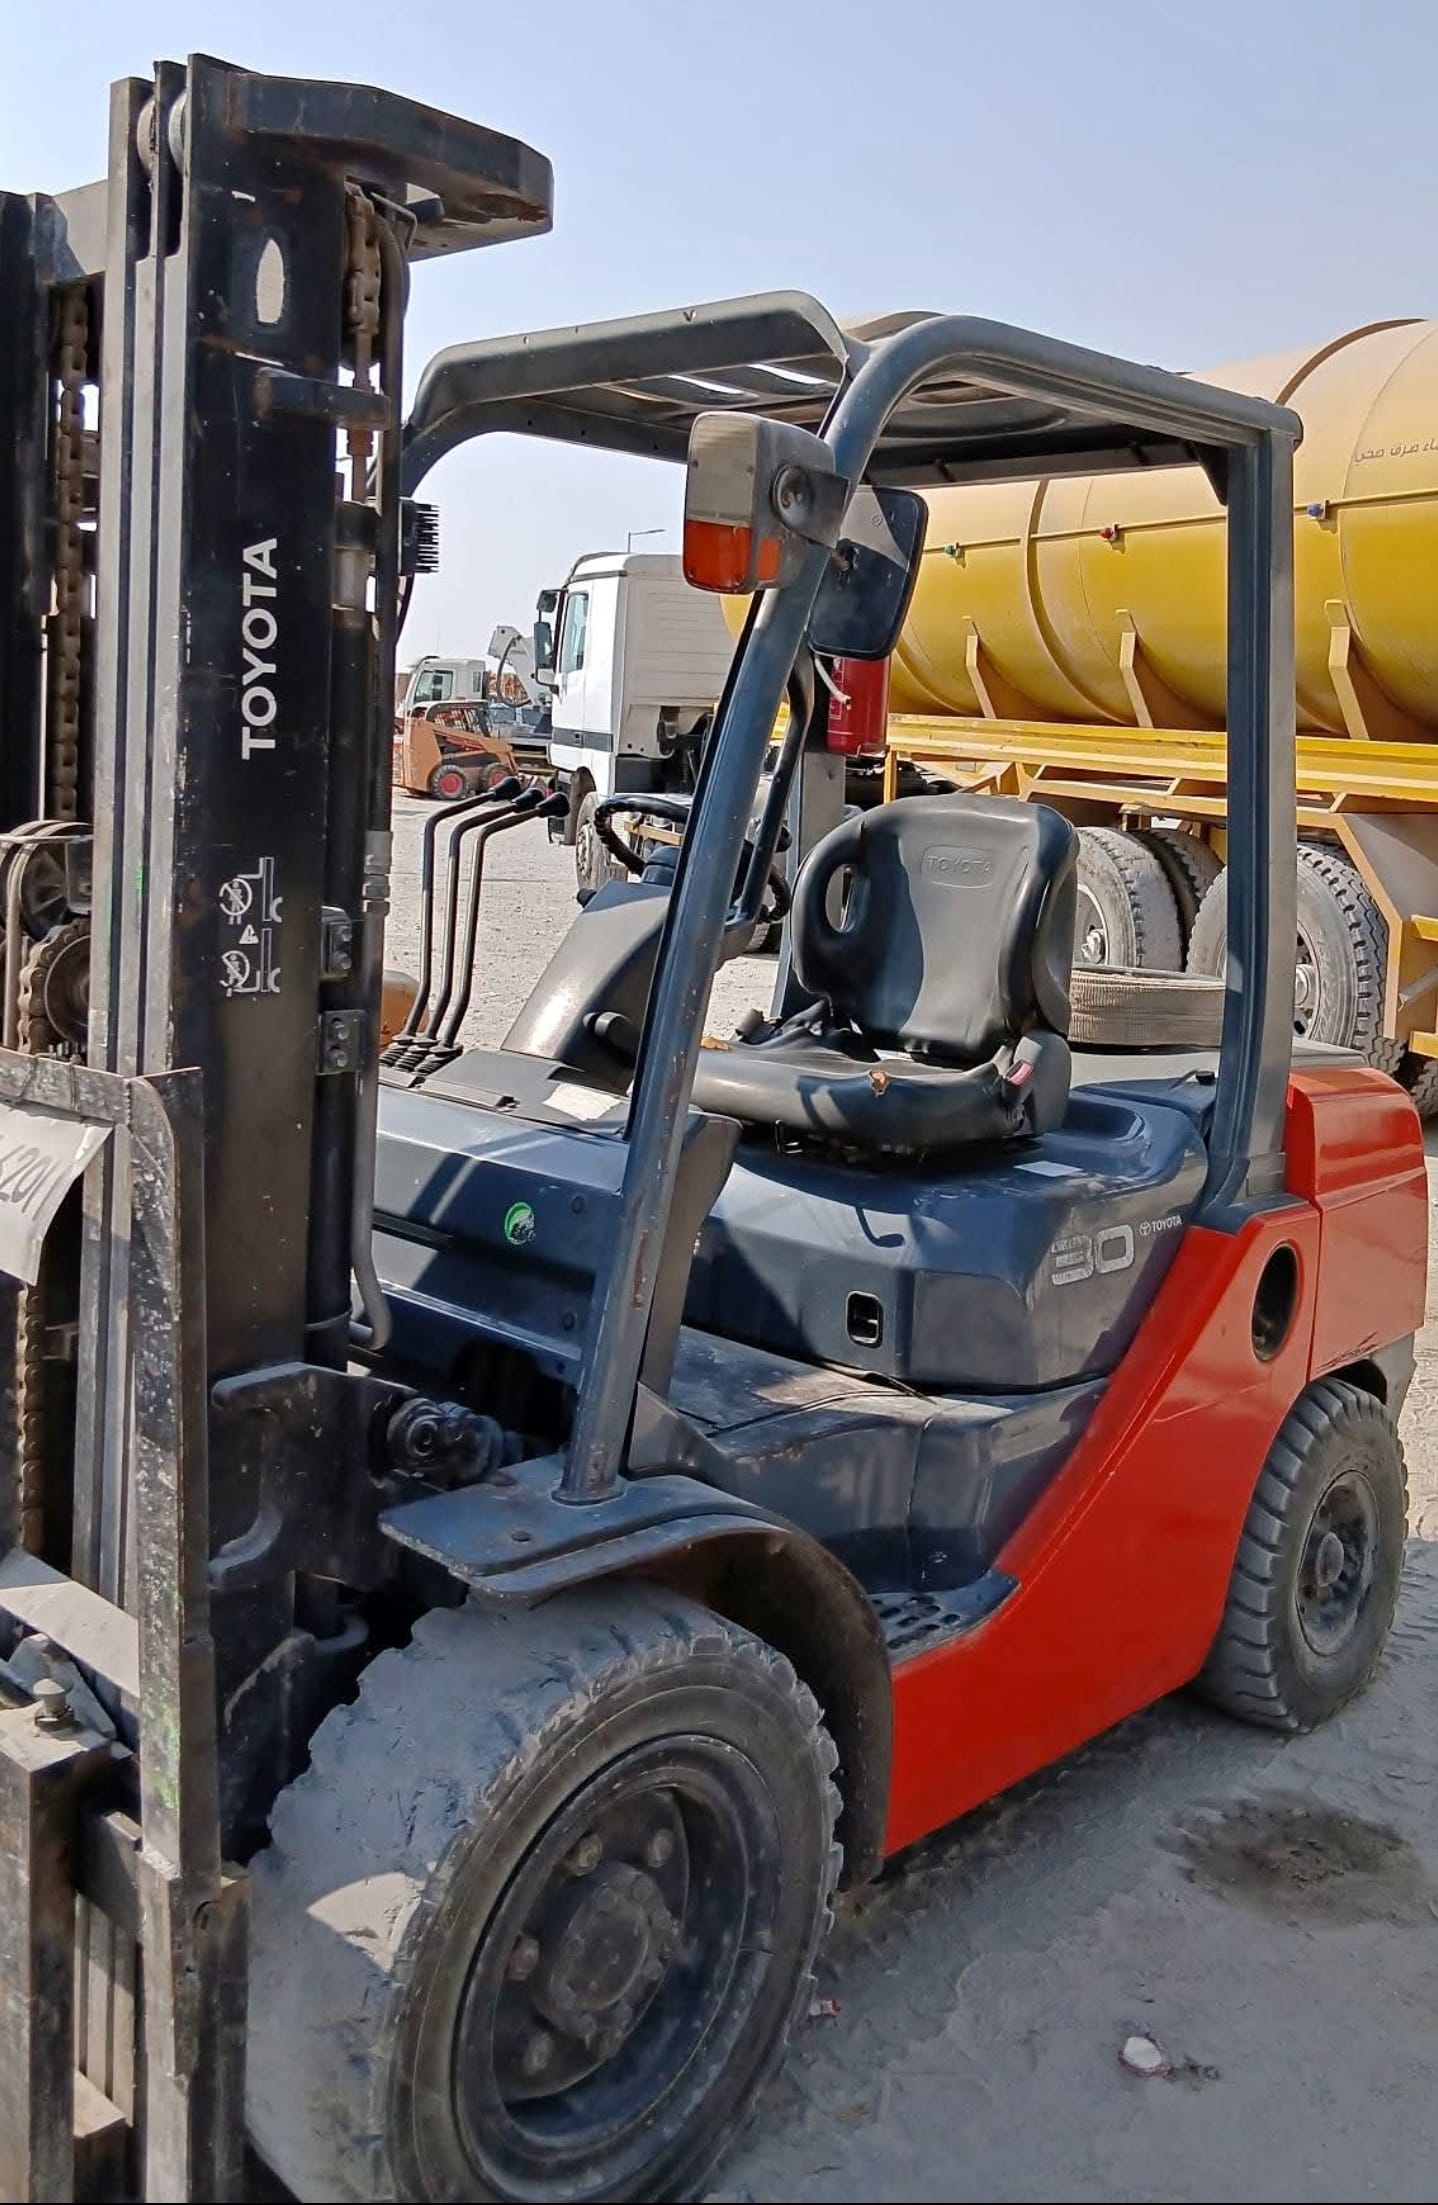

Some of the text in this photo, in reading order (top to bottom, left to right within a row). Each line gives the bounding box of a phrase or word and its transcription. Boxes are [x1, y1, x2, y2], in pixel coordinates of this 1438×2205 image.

[1390, 442, 1419, 458] صرف
[241, 537, 278, 760] TOYOTA
[927, 855, 991, 873] TOYOTA
[1051, 1214, 1182, 1286] 30 TOYOTA
